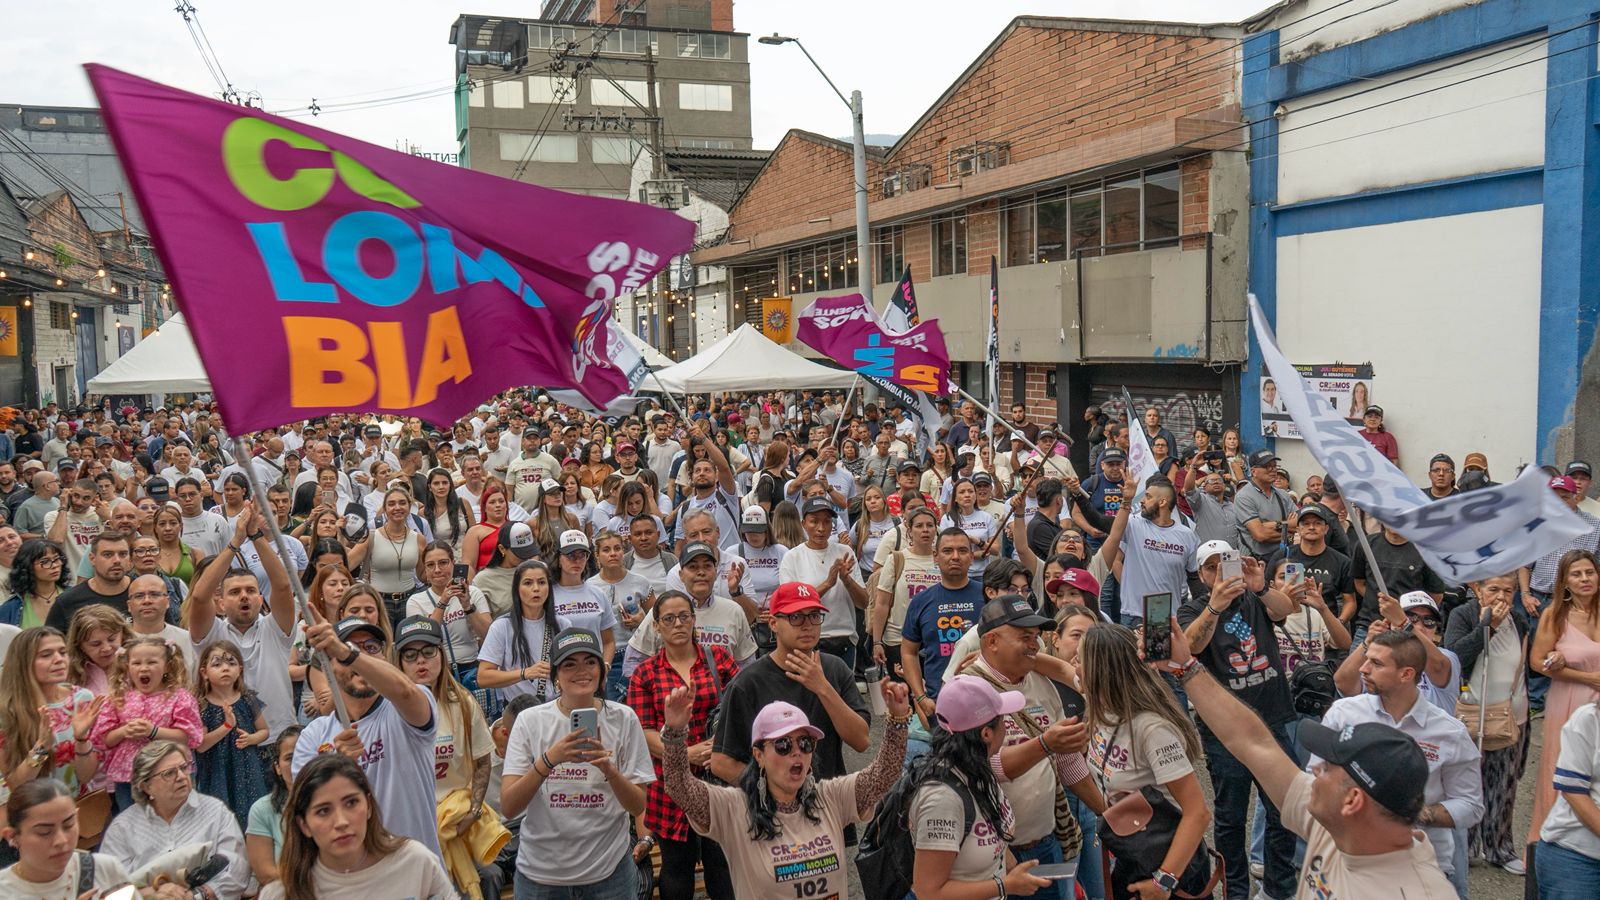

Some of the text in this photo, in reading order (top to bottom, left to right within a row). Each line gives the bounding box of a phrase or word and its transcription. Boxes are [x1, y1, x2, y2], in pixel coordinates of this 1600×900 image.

[281, 305, 473, 410] BIA
[522, 475, 542, 483] 102
[1229, 667, 1278, 690] USA
[1155, 742, 1180, 756] FIRME
[1159, 755, 1185, 767] PATRIA
[550, 793, 604, 803] CREEMOS
[927, 819, 957, 828] FIRME
[928, 832, 955, 841] PATRIA
[776, 856, 837, 875] SIMÓN MOLINA
[823, 864, 838, 873] VOTA
[794, 877, 828, 899] 102
